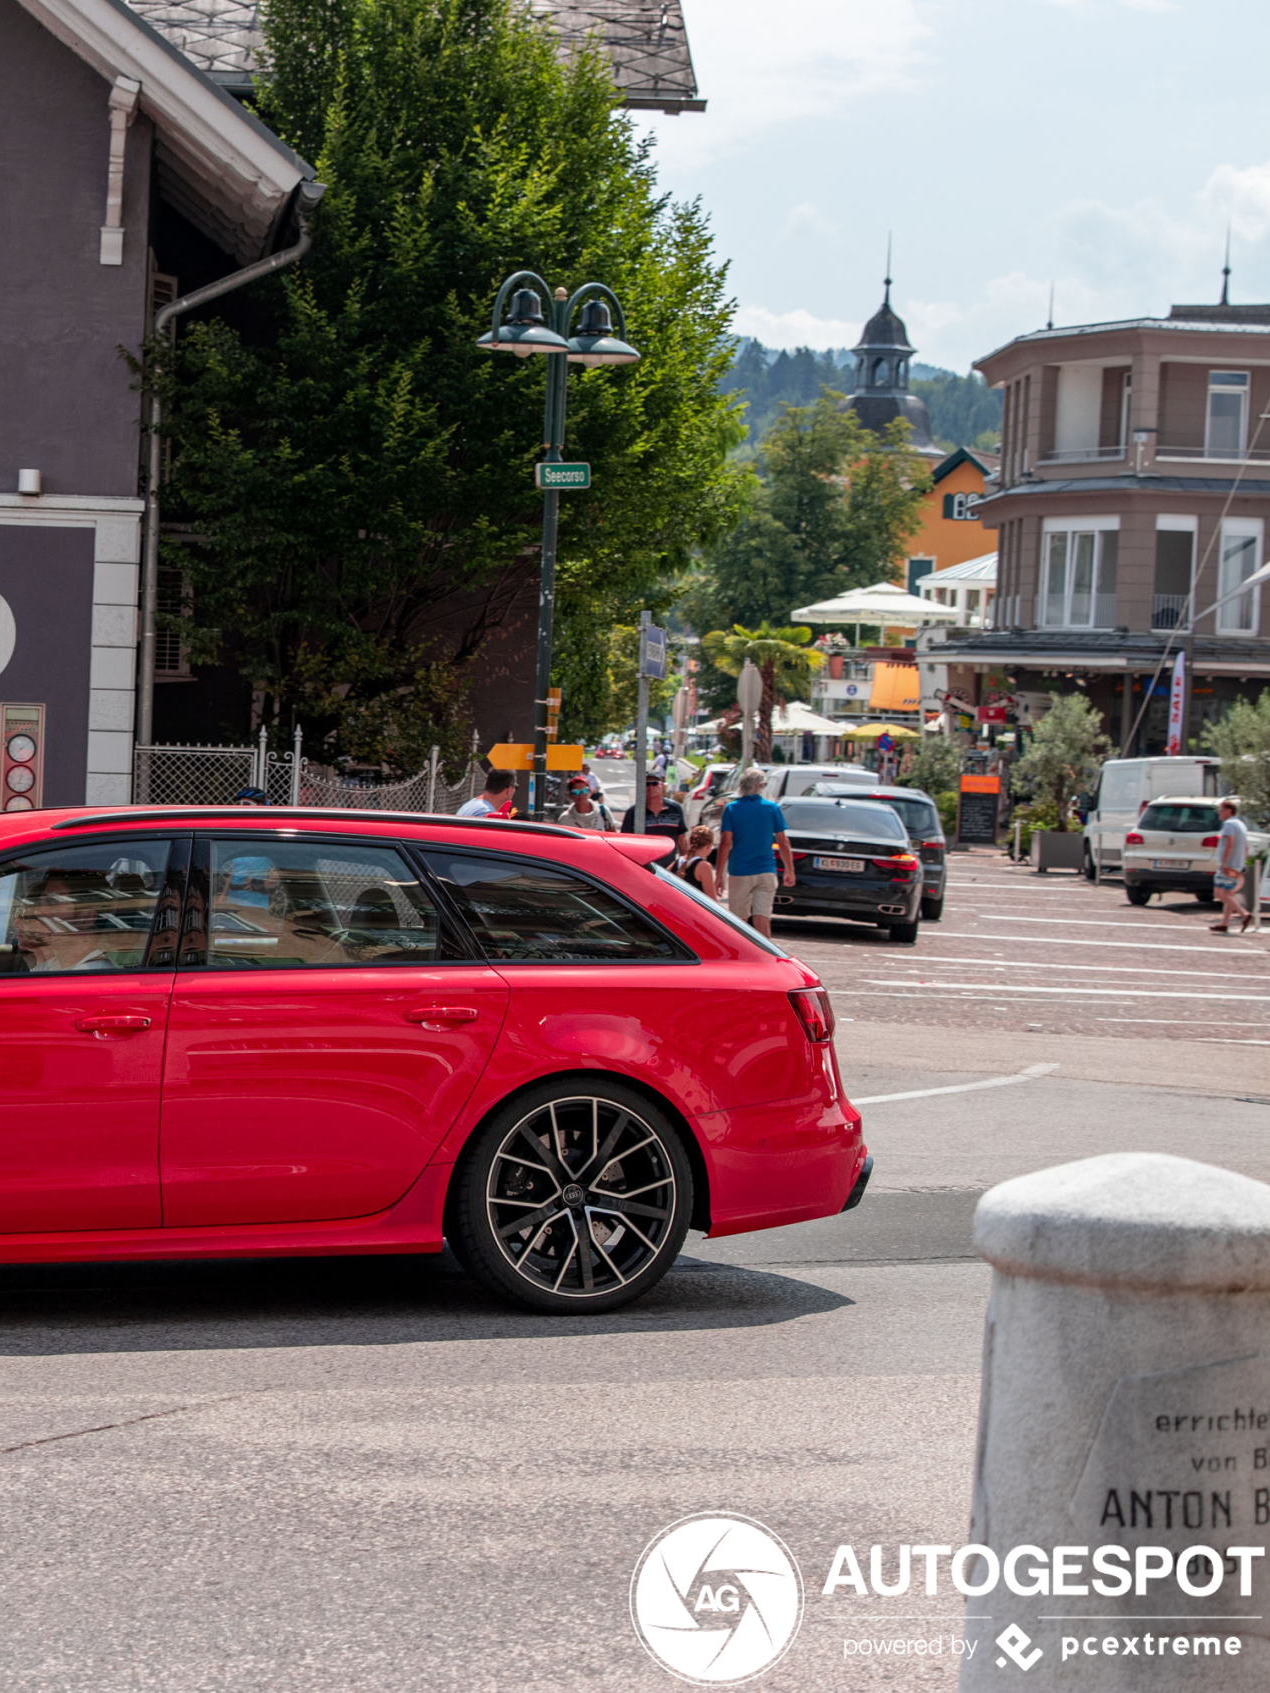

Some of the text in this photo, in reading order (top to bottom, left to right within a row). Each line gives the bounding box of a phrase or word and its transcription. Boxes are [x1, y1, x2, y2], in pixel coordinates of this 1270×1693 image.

[545, 467, 585, 483] Seecorso
[1191, 1456, 1237, 1472] von
[1100, 1488, 1232, 1529] ANTON
